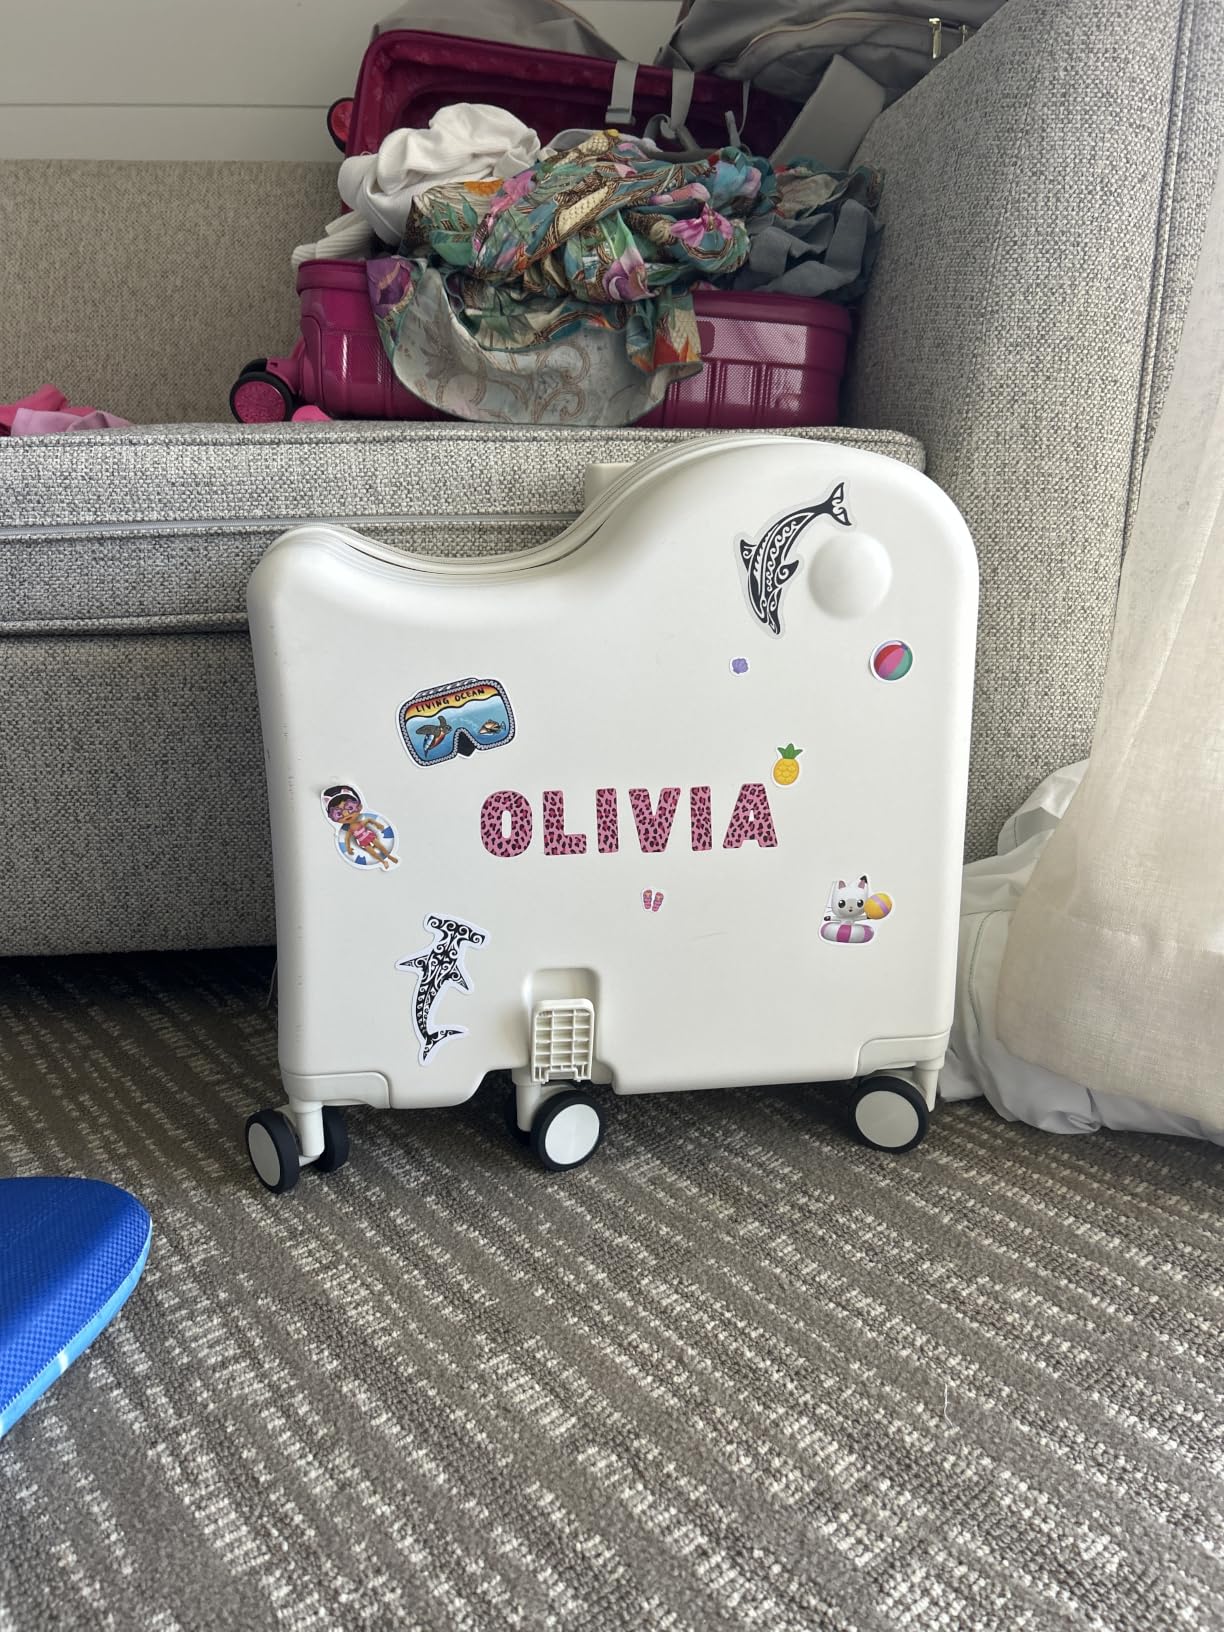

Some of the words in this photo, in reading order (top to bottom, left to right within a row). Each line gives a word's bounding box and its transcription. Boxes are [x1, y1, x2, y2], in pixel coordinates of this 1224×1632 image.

[415, 697, 449, 712] LIVING
[454, 688, 485, 701] OCEAN
[480, 783, 778, 857] OLIVIA
